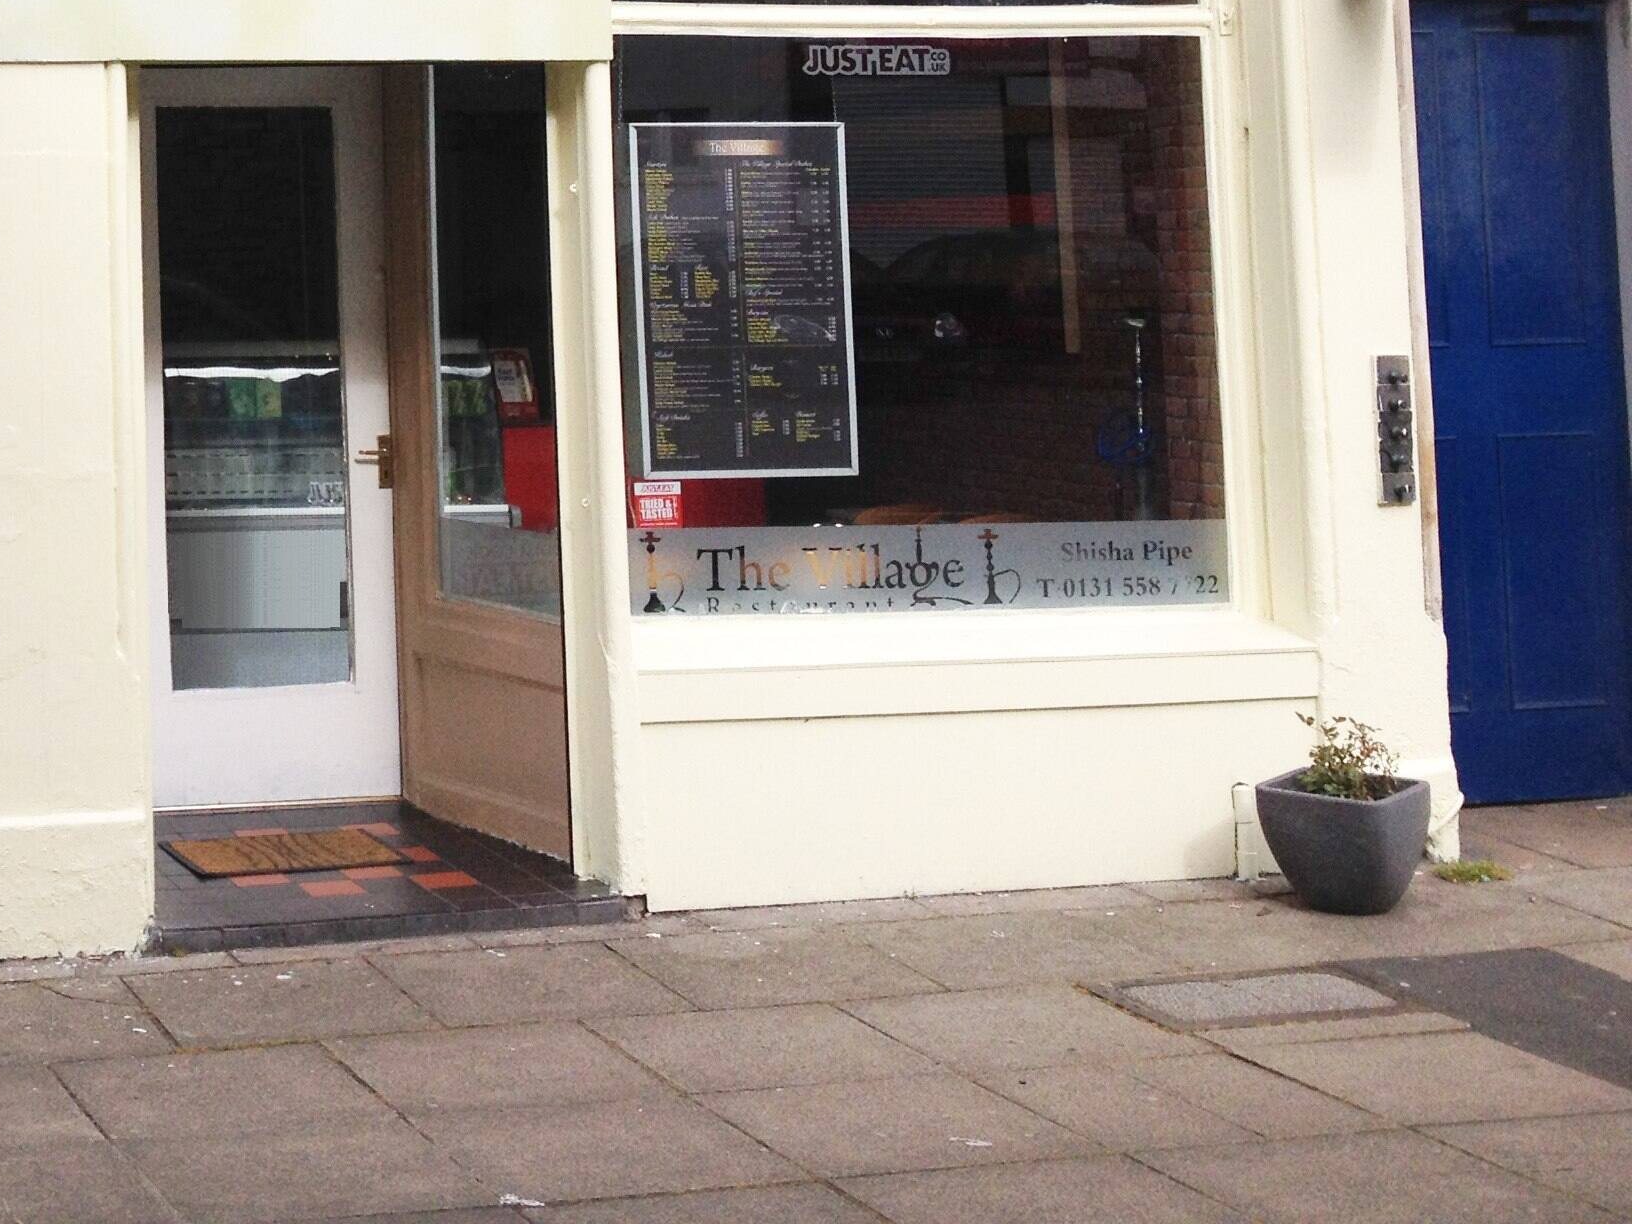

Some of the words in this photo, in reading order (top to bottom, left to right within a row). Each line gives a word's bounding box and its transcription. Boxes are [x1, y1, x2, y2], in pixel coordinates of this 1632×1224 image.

[640, 498, 665, 510] TRIED
[640, 507, 673, 521] TASTED
[1060, 540, 1135, 563] Shisha
[1142, 539, 1194, 567] Pipe
[696, 545, 792, 593] The
[801, 526, 975, 609] Village
[1122, 576, 1161, 597] 558
